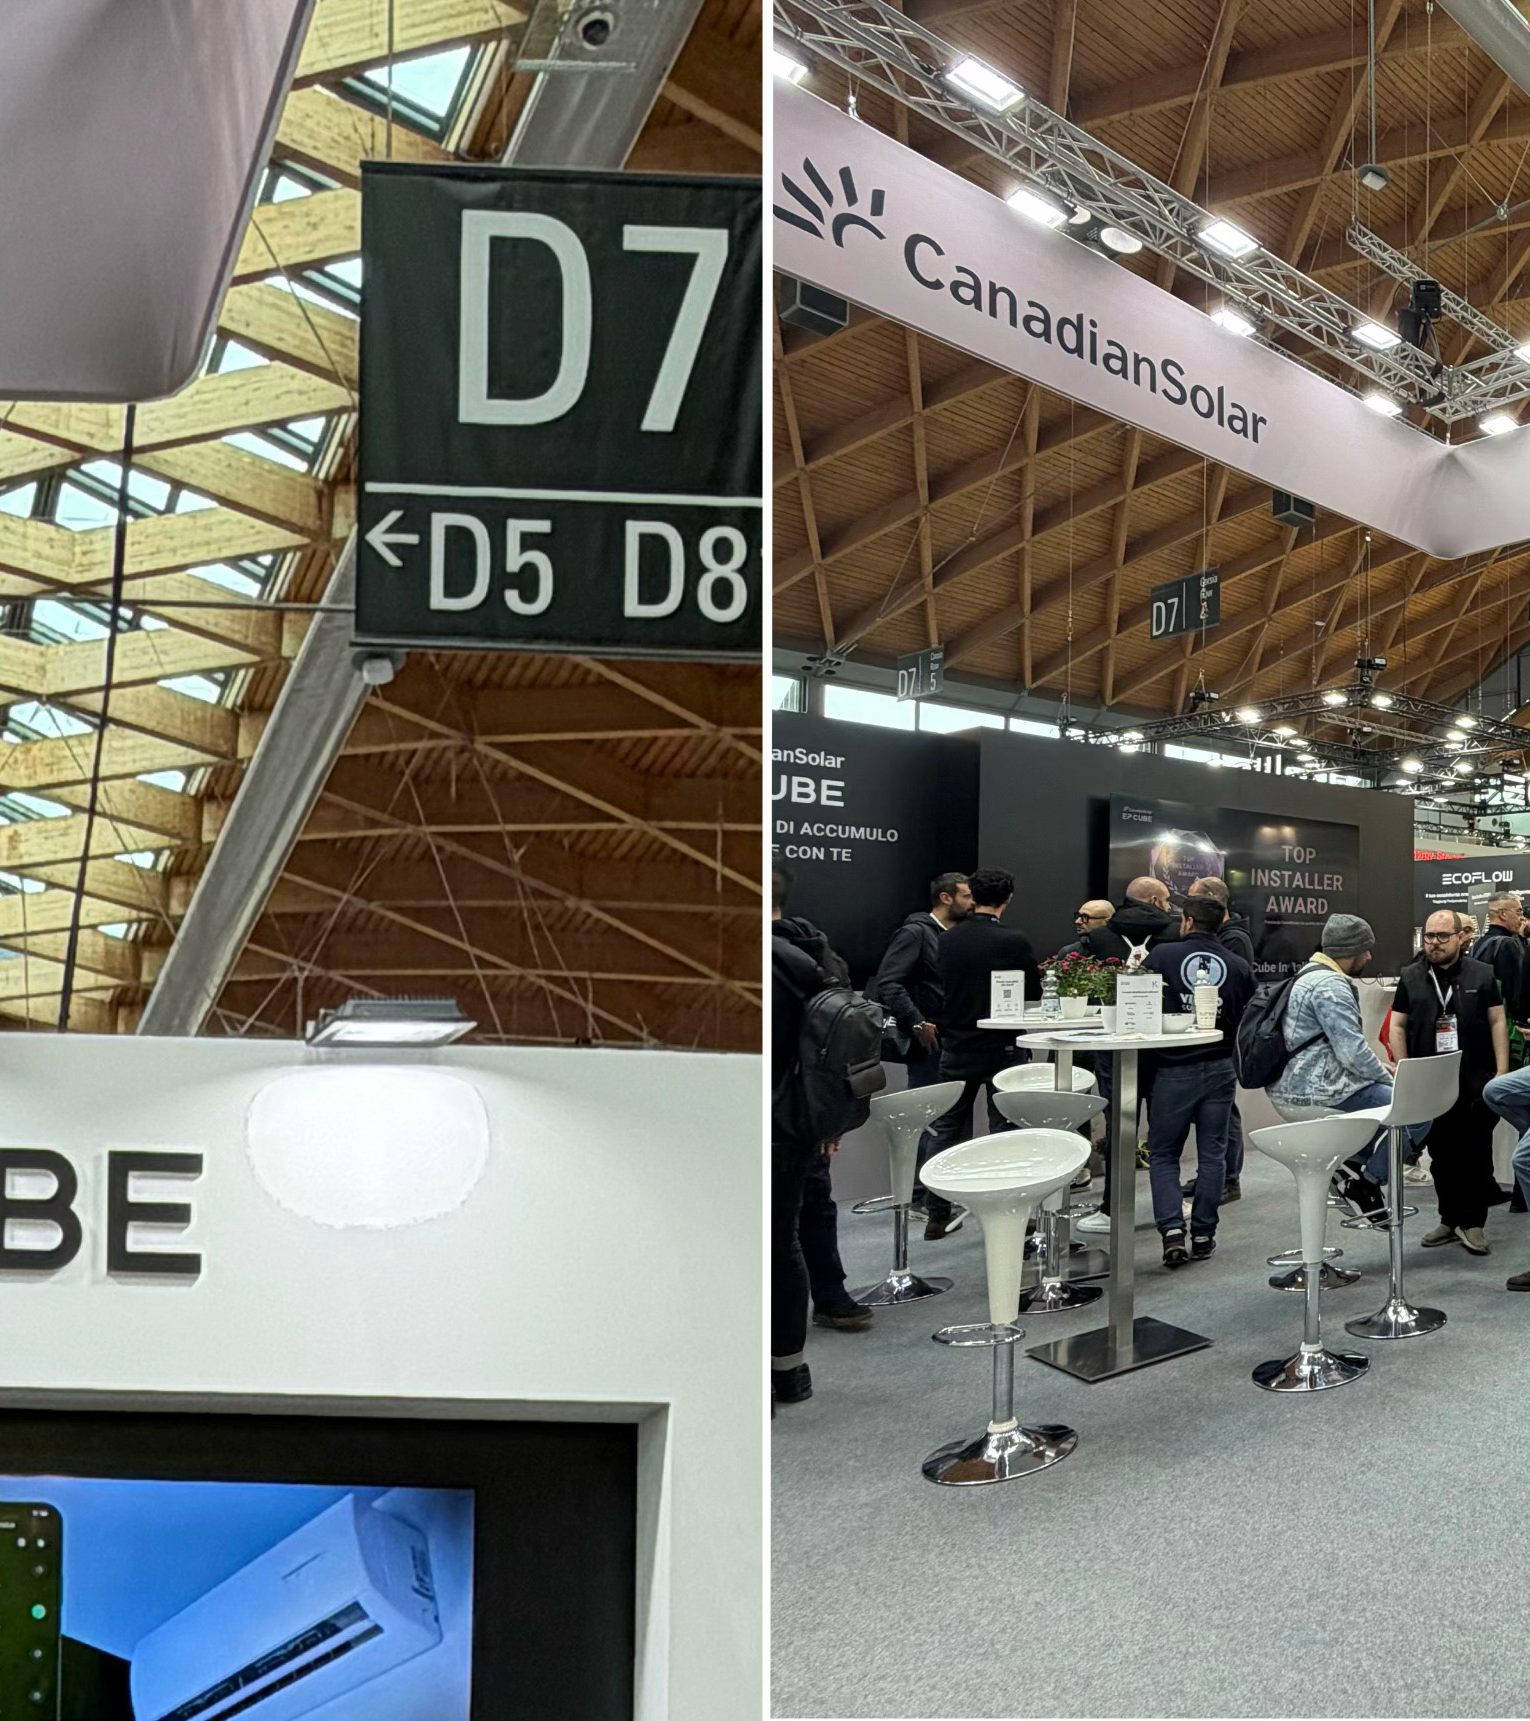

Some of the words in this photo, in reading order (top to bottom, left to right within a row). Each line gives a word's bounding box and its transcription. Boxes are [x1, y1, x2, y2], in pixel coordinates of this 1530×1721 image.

[457, 209, 729, 433] D7
[903, 231, 1268, 446] CanadianSolar
[427, 512, 554, 616] D5
[623, 518, 748, 623] D8
[1152, 596, 1179, 637] D7
[898, 667, 917, 698] D7
[930, 672, 937, 691] 5
[776, 819, 795, 835] DI
[799, 821, 899, 842] ACCUMULO
[785, 844, 825, 860] CON
[829, 847, 852, 862] TE
[1281, 844, 1317, 864] TOP
[1250, 867, 1344, 892] INSTALLER
[1442, 870, 1513, 886] ECOFLOW
[1266, 895, 1329, 915] AWARD
